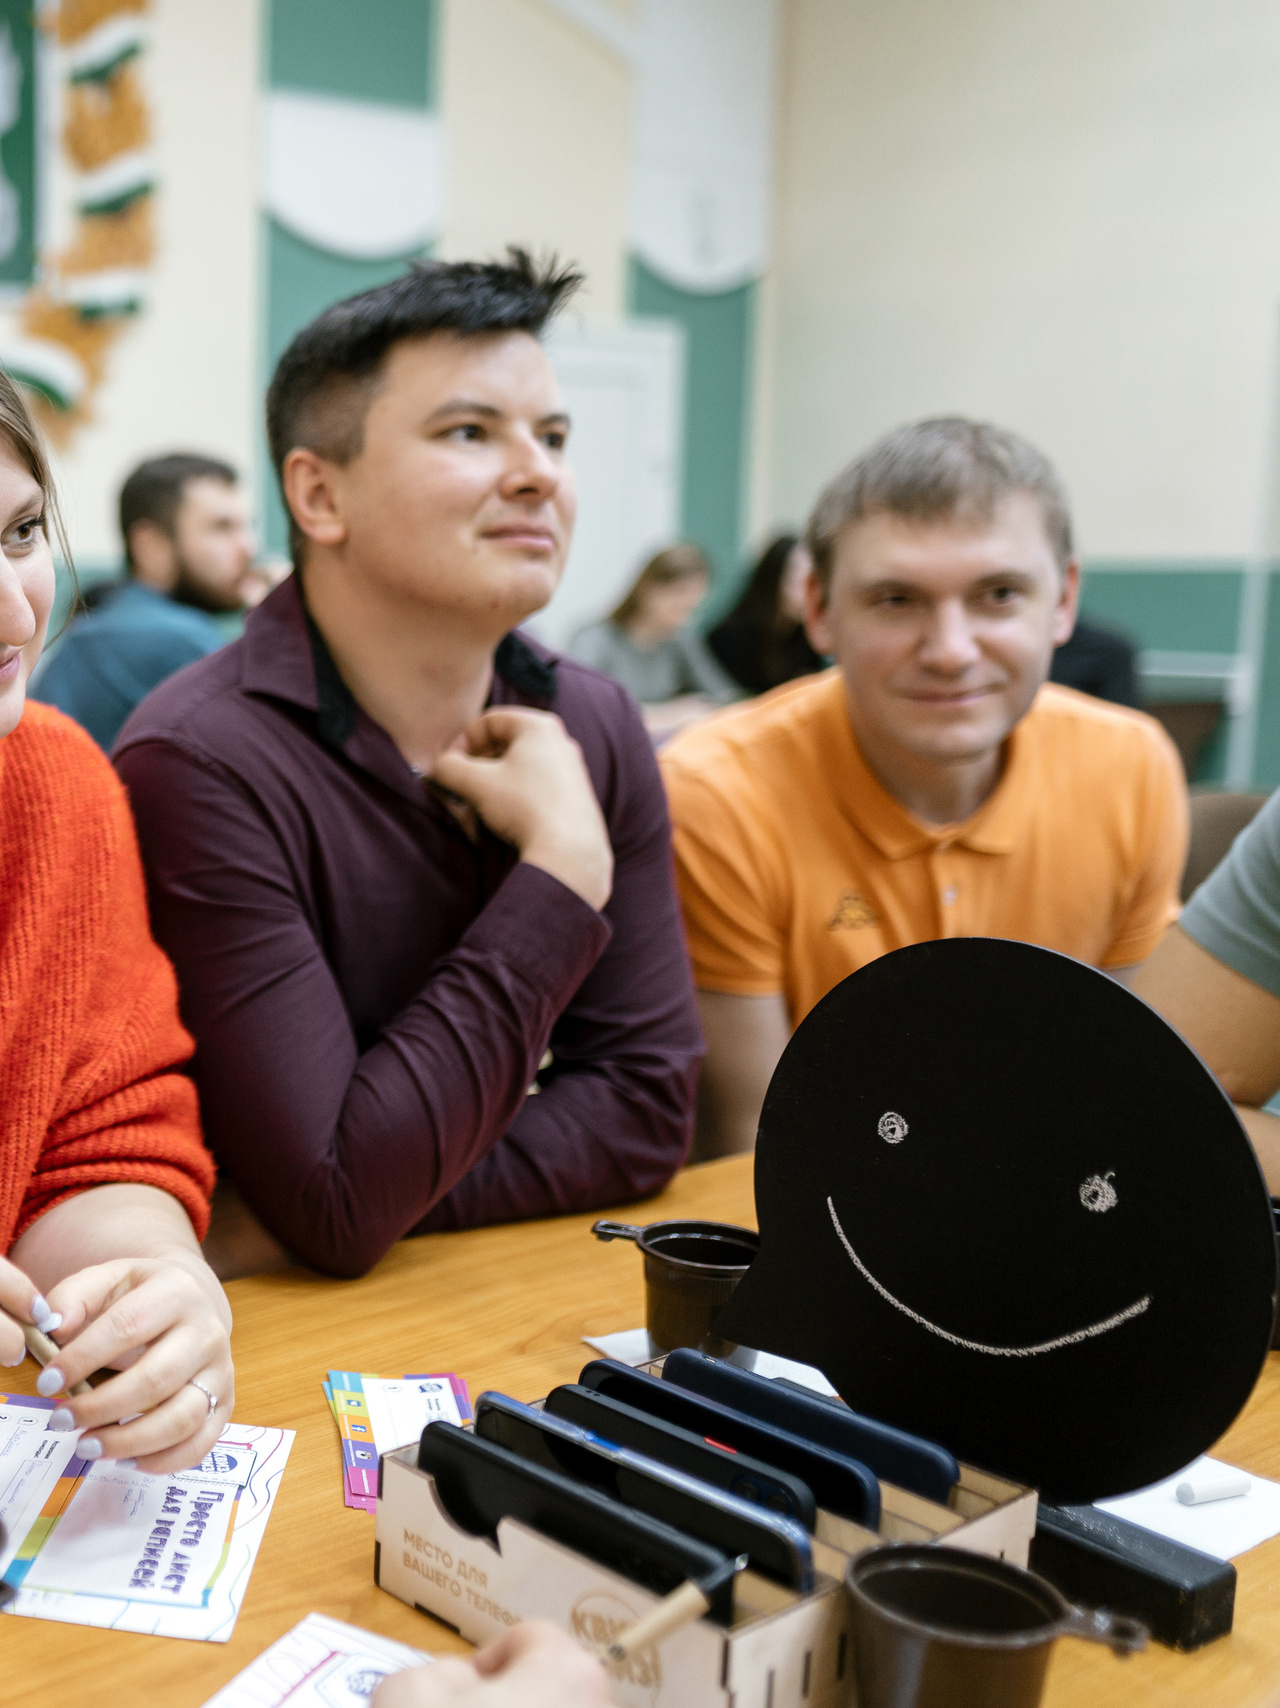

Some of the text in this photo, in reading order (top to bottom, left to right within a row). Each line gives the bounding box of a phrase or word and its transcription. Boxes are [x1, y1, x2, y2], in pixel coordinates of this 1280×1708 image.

[213, 1452, 231, 1472] КВИЗ
[161, 1486, 188, 1515] для
[128, 1519, 176, 1590] записей
[161, 1490, 225, 1595] Просто лист
[403, 1527, 488, 1590] МЕСТО ДЛЯ
[403, 1550, 523, 1627] ВАШЕГО ТЕЛЕФ
